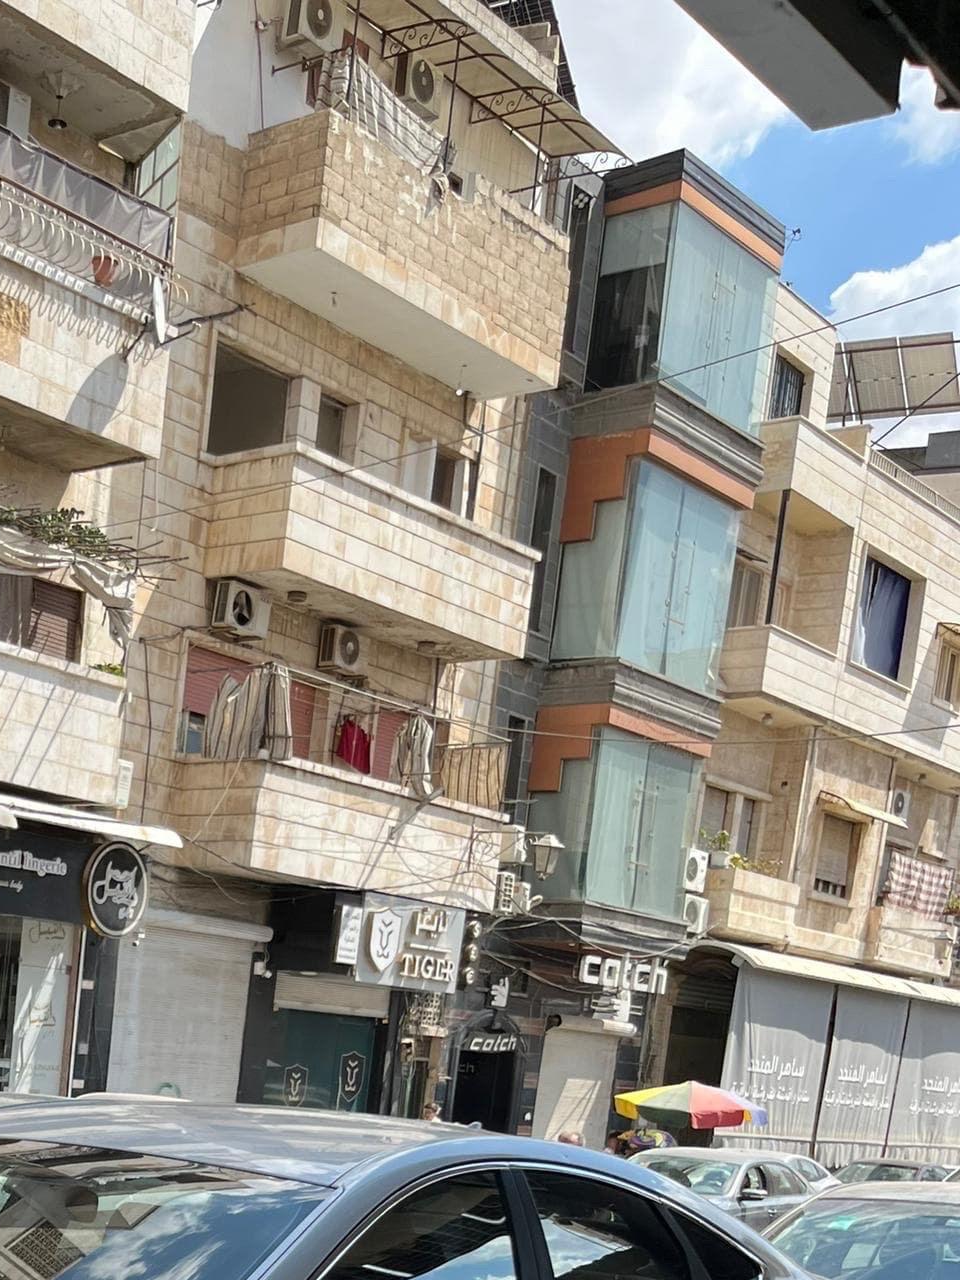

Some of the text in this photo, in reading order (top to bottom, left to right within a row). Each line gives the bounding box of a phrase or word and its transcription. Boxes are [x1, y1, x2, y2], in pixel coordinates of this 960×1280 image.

[22, 851, 68, 877] lingerie
[399, 952, 456, 982] TIGER
[777, 1057, 805, 1080] سامر
[863, 1066, 888, 1088] سامر
